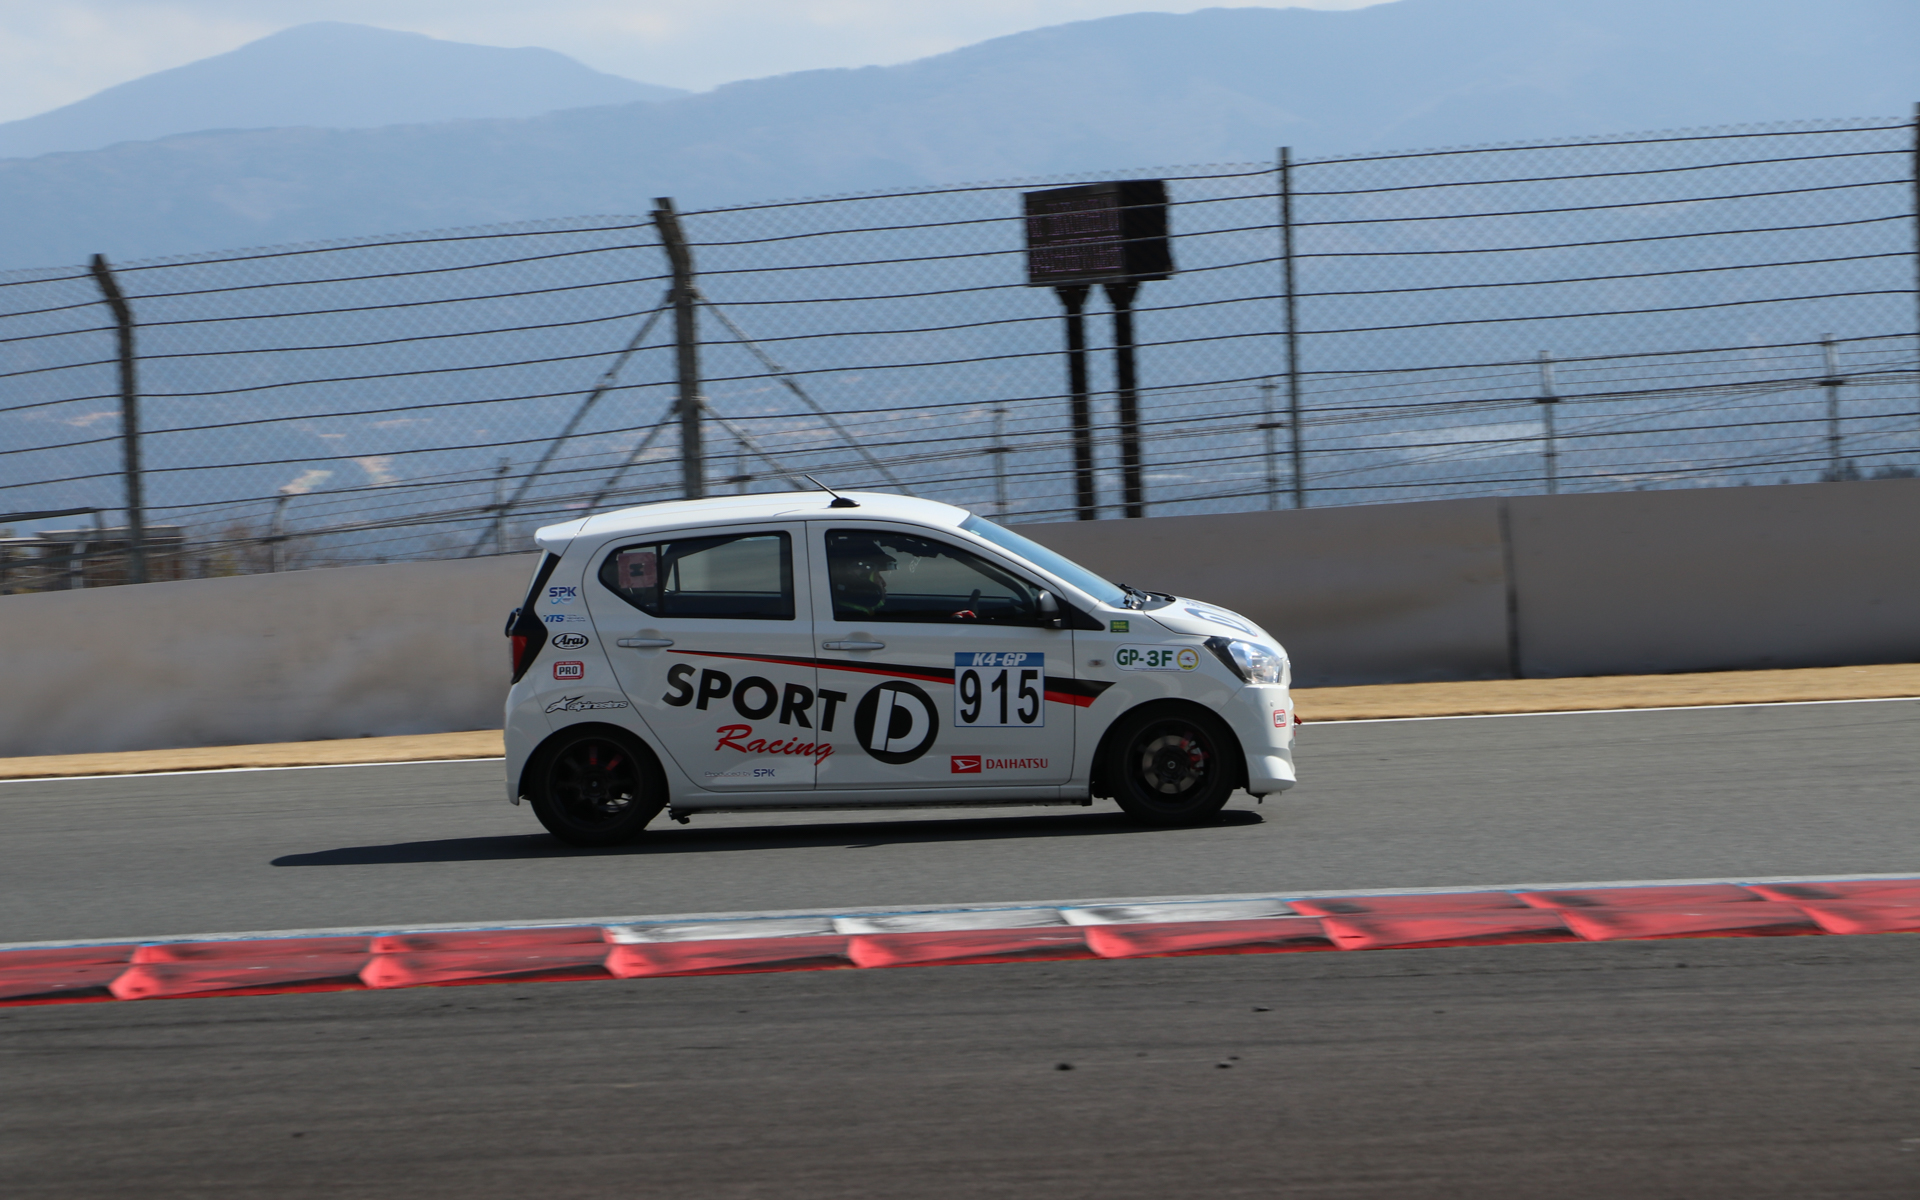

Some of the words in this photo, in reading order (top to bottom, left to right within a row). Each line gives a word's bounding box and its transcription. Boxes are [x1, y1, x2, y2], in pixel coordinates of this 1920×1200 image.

[549, 586, 577, 597] SPK
[555, 635, 584, 645] Arai
[972, 652, 1028, 667] K4-GP
[1116, 648, 1173, 667] GP-3F
[558, 666, 578, 675] PRO
[662, 663, 848, 732] SPORT
[959, 669, 1040, 725] 915
[714, 724, 836, 766] Racing
[985, 758, 1049, 770] DAIHATSU
[753, 768, 775, 778] SPK
